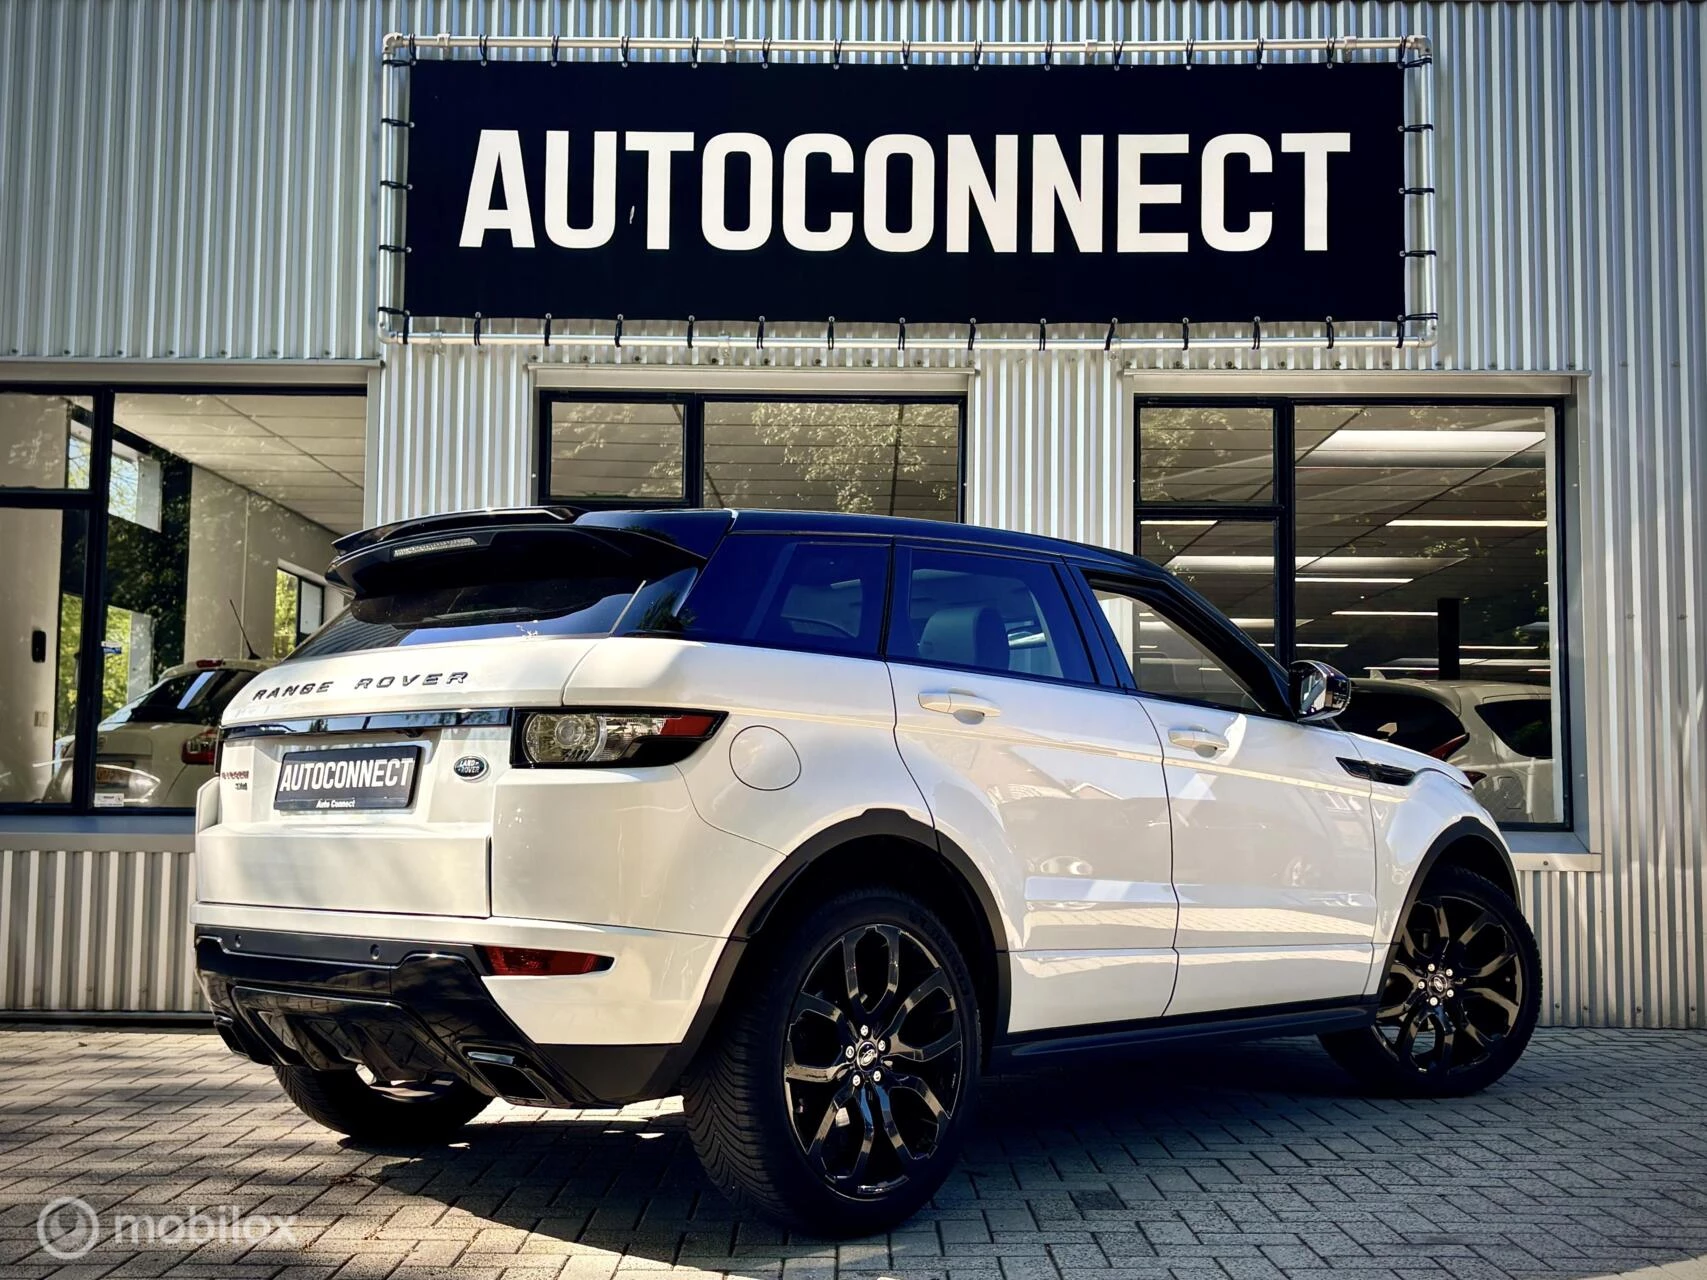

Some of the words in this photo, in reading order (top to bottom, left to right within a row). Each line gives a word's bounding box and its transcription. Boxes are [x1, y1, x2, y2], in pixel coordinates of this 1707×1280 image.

[458, 129, 1352, 254] AUTOCONNECT
[252, 680, 334, 701] RANGE
[354, 671, 469, 690] ROVER
[279, 757, 414, 792] AUTOCONNECT
[315, 799, 330, 809] Auto
[330, 798, 356, 808] Connect
